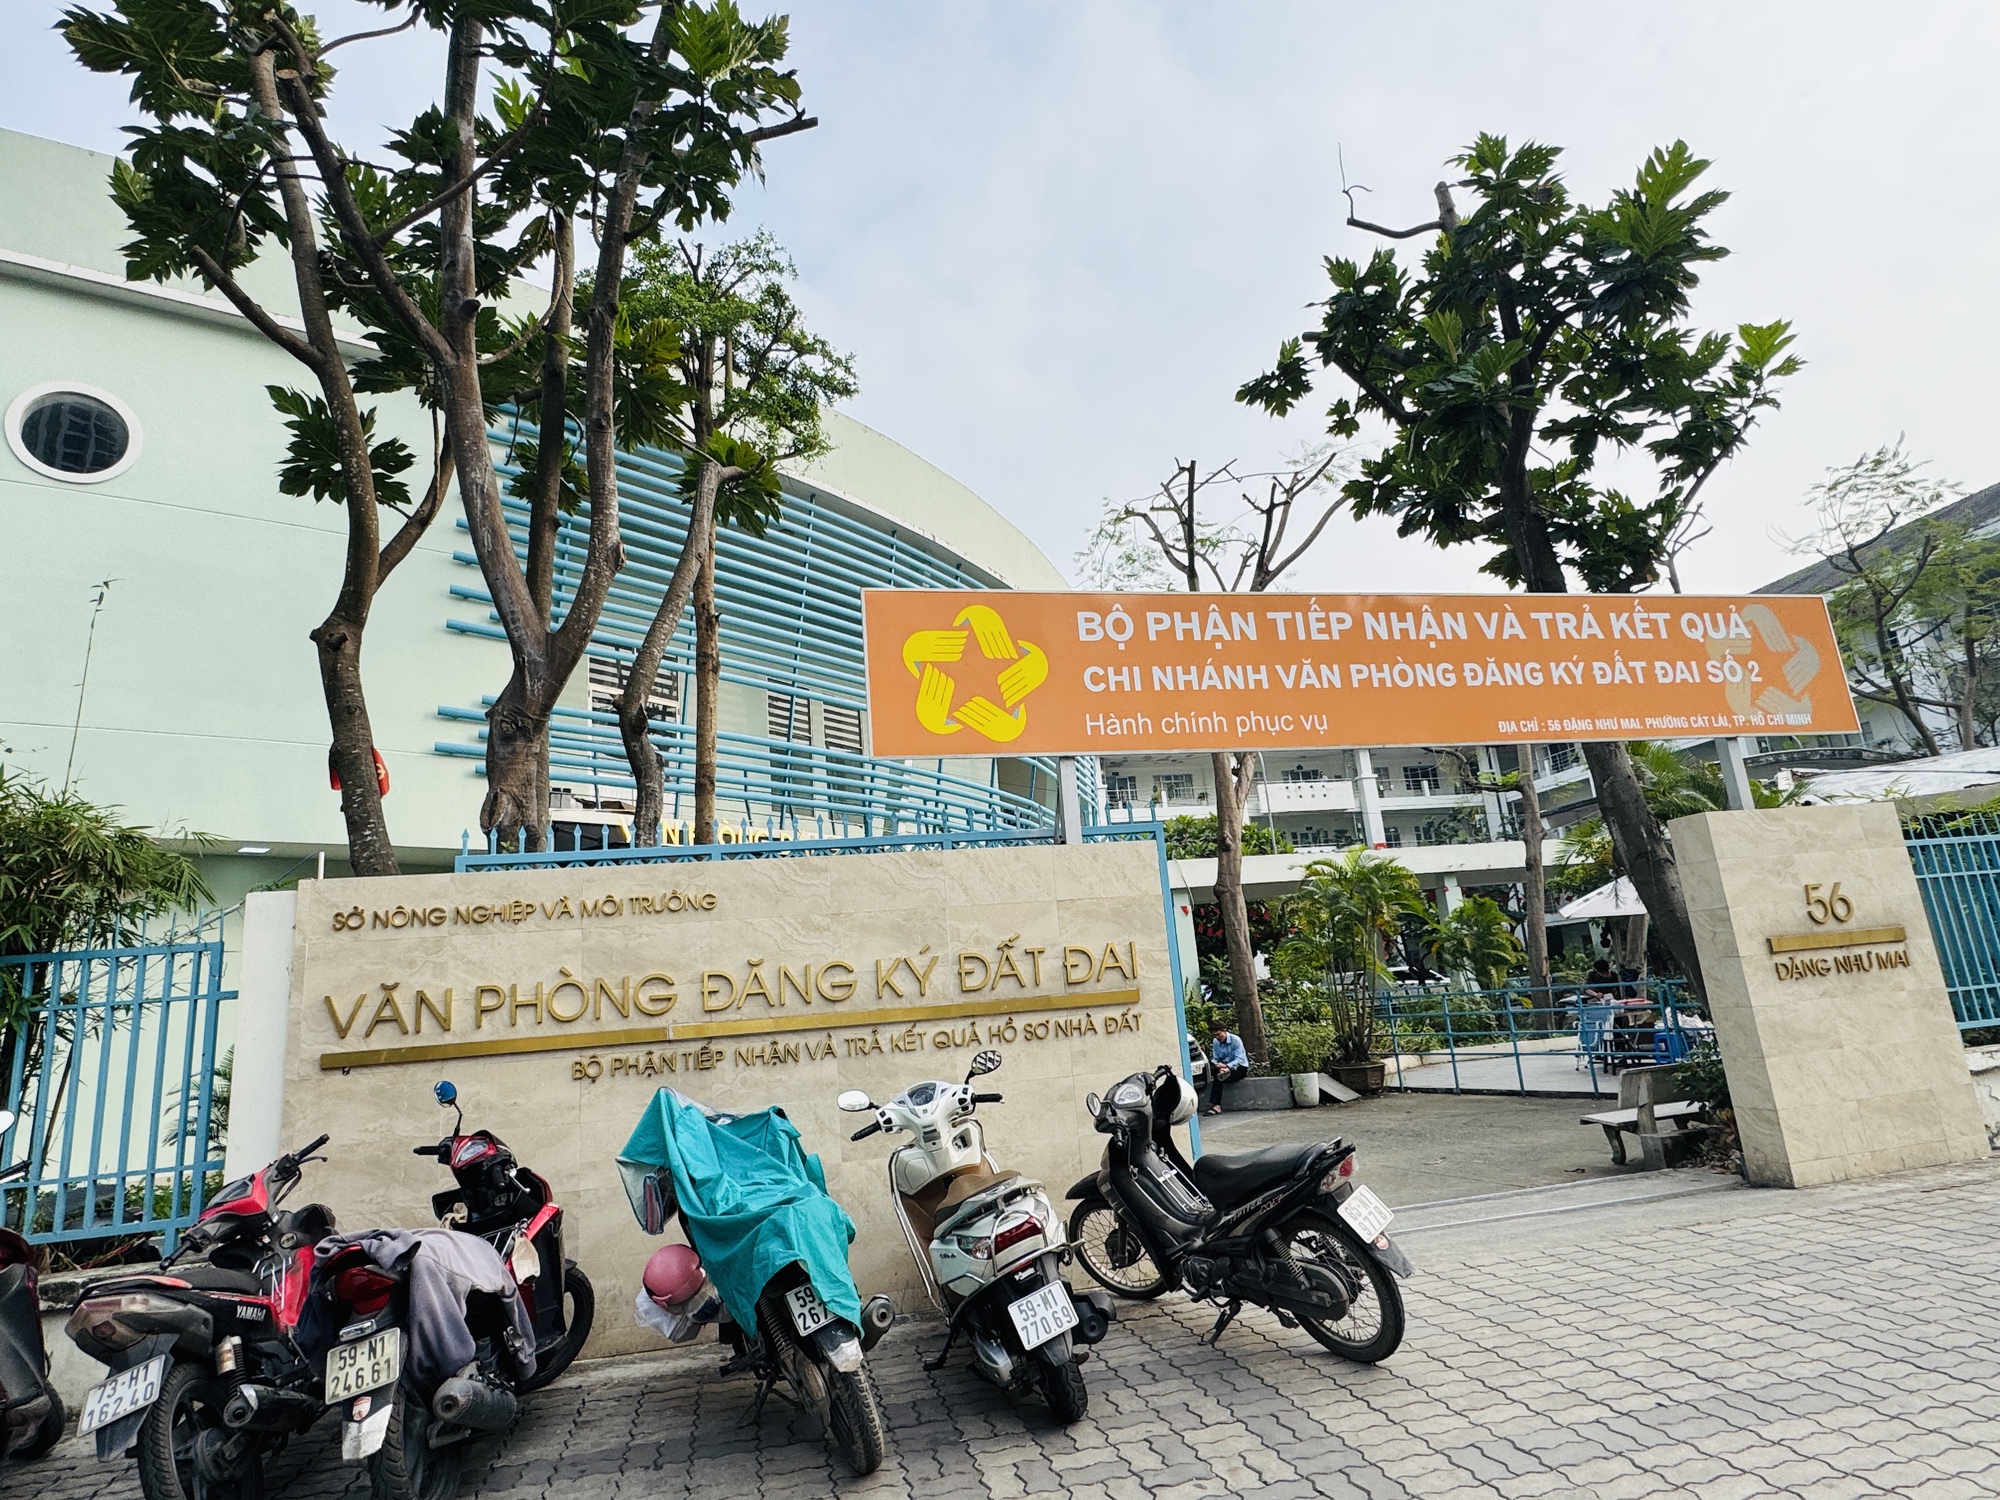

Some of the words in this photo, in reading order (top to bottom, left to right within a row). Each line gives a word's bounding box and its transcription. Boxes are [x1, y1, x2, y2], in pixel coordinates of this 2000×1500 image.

[1077, 603, 1134, 650] BỘ
[1146, 603, 1257, 650] PHẬN
[1266, 597, 1353, 641] TIẾP
[1363, 604, 1468, 648] NHẬN
[1473, 603, 1527, 640] VÀ
[1530, 603, 1605, 640] TRẢ
[1609, 599, 1671, 640] KẾT
[1680, 604, 1752, 643] QUẢ
[1083, 665, 1142, 692] CHI
[1152, 657, 1269, 691] NHÁNH
[1275, 658, 1341, 689] VĂN
[1349, 656, 1457, 688] PHÒNG
[1463, 656, 1544, 687] ĐĂNG
[1549, 654, 1585, 685] KÝ
[1592, 650, 1647, 685] ĐẤT
[1654, 660, 1701, 684] ĐAI
[1706, 649, 1743, 683] SỐ
[1747, 660, 1763, 682] 2
[1085, 712, 1153, 736] Hành
[1161, 711, 1228, 734] chính
[1236, 710, 1295, 738] phục
[1300, 714, 1328, 735] vụ
[1498, 720, 1518, 735] ĐỊA
[1520, 716, 1539, 732] CHỈ
[1547, 719, 1562, 732] 56
[1563, 717, 1594, 734] ĐẶNG
[1595, 716, 1618, 731] NHƯ
[1645, 713, 1689, 729] PHƯỜNG
[1690, 713, 1711, 728] CÁT
[1711, 713, 1732, 729] LÁI,
[1751, 711, 1766, 726] HỒ
[1766, 711, 1785, 726] CHÍ
[1785, 713, 1812, 725] MINH
[332, 905, 366, 932] SỞ
[372, 904, 447, 930] NÔNG
[453, 900, 537, 925] NGHIỆP
[541, 895, 575, 920] VÀ
[580, 893, 624, 918] MÔI
[629, 889, 718, 915] TRƯỜNG
[1804, 881, 1854, 924] 56
[1833, 950, 1873, 975] NHƯ
[1875, 949, 1911, 970] MAI
[324, 981, 454, 1039] VĂN
[475, 966, 679, 1029] PHÒNG
[701, 958, 858, 1012] ĐĂNG
[875, 944, 940, 998] KÝ
[957, 933, 1046, 992] ĐẤT
[1063, 940, 1140, 985] ĐAI
[571, 1055, 604, 1083] BỘ
[610, 1051, 677, 1078] PHẬN
[682, 1038, 726, 1070] TIẾP
[735, 1040, 800, 1066] NHẬN
[804, 1032, 838, 1061] VÀ
[844, 1028, 884, 1057] TRẢ
[890, 1022, 927, 1052] KẾT
[932, 1021, 982, 1050] QUẢ
[988, 1016, 1018, 1045] HỒ
[1023, 1018, 1050, 1041] SƠ
[1054, 1013, 1098, 1038] NHÀ
[1104, 1007, 1143, 1035] ĐẤT
[1358, 1205, 1388, 1236] 9778
[236, 1305, 266, 1321] YAMAHA
[1021, 1305, 1073, 1345] 770.69
[338, 1335, 385, 1371] 59-N1
[97, 1364, 149, 1404] 73-H1
[331, 1357, 391, 1399] 246.61
[87, 1381, 155, 1429] 162.40
